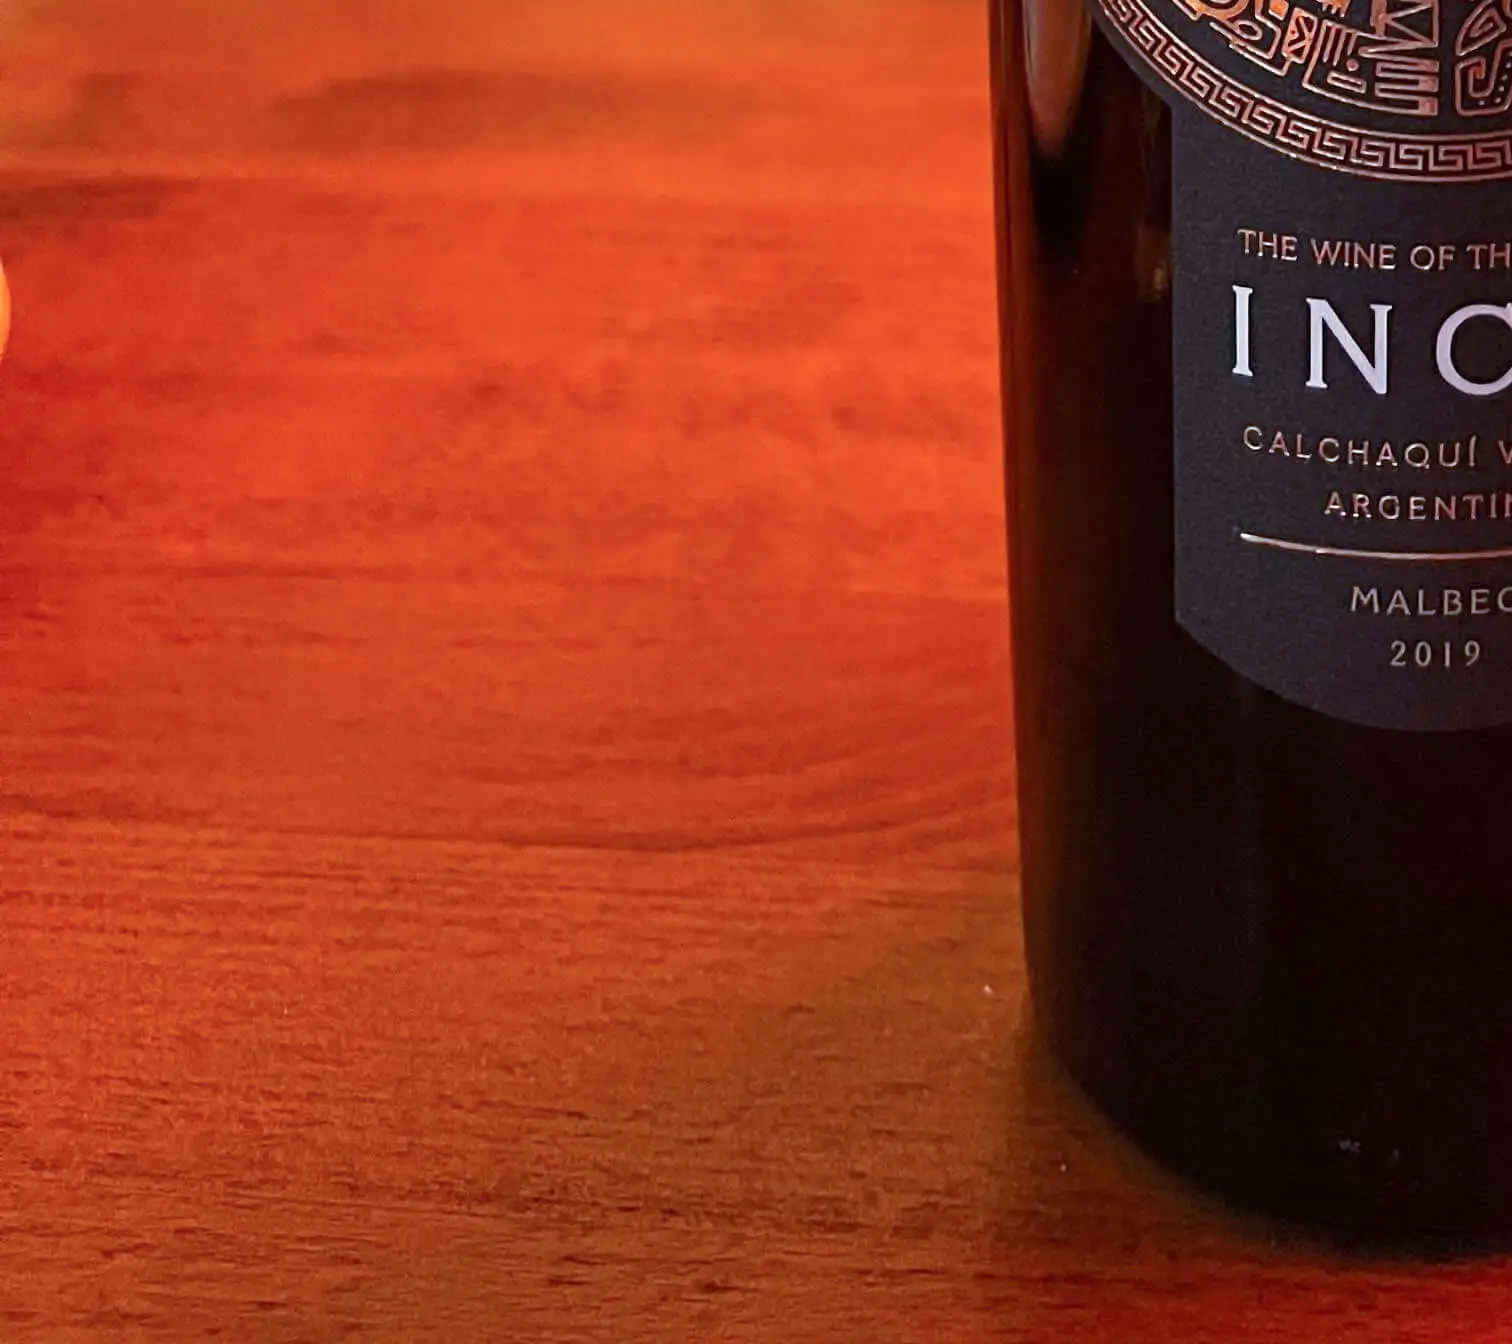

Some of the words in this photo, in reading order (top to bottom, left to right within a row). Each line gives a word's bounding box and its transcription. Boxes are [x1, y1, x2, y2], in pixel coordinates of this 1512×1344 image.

[1236, 228, 1299, 262] THE
[1310, 237, 1397, 270] WINE
[1409, 245, 1456, 271] OF
[1390, 640, 1481, 668] 2019
